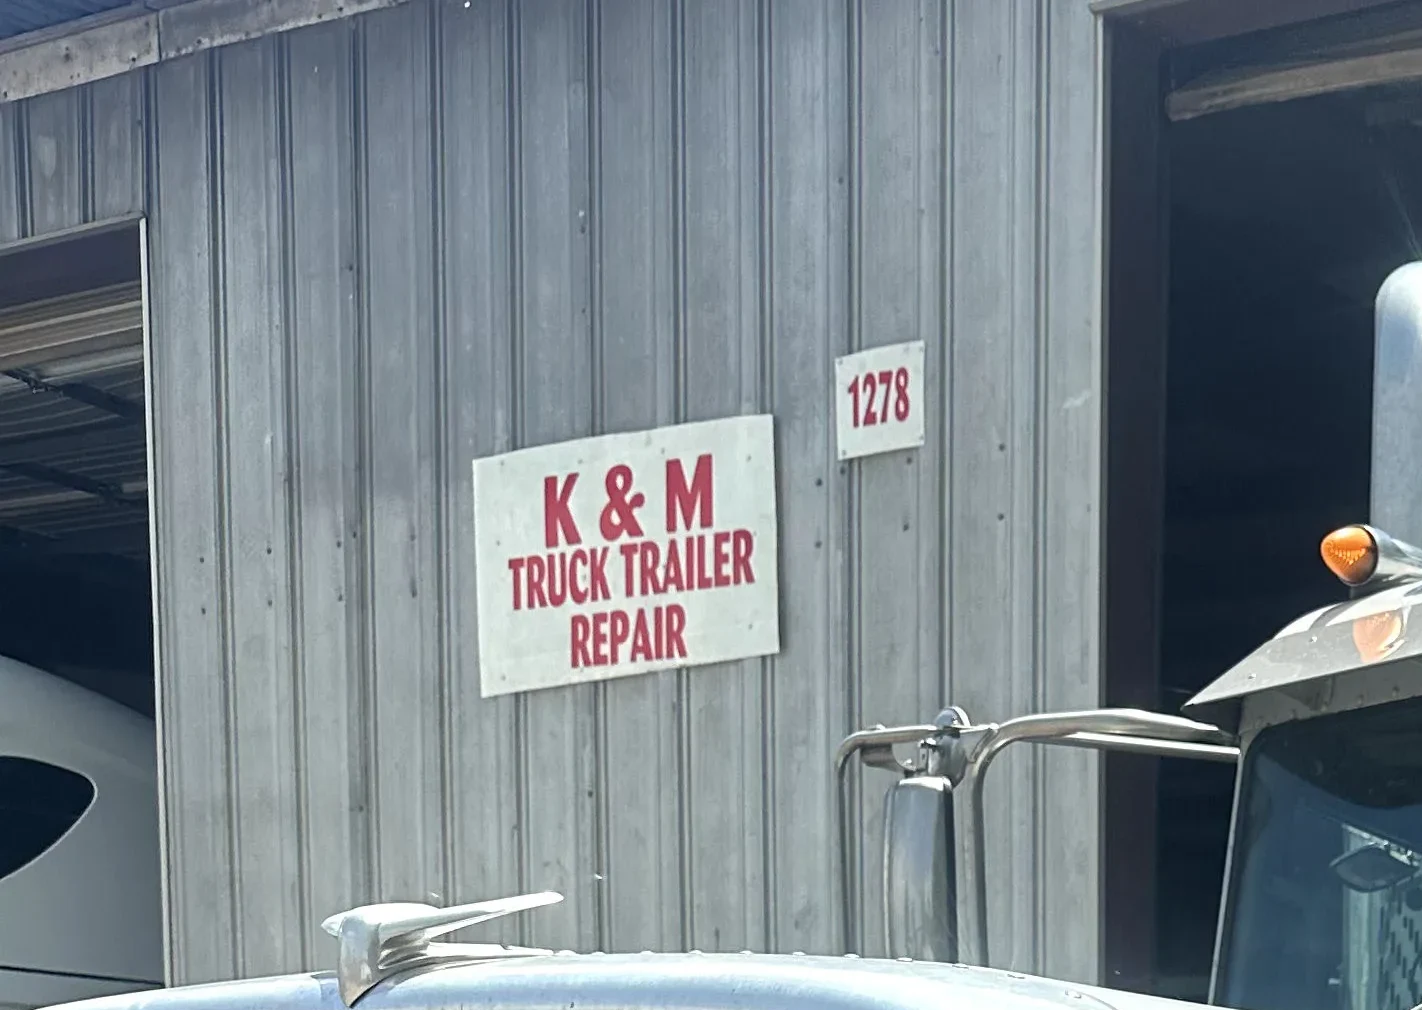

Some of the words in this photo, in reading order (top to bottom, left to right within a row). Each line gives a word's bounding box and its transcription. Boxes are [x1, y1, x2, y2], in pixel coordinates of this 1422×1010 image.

[847, 366, 911, 428] 1278
[543, 472, 582, 548] K
[599, 464, 645, 542] &
[665, 453, 714, 533] M
[508, 546, 611, 611] TRUCK
[619, 528, 756, 599] TRAILER
[570, 603, 687, 669] REPAIR
